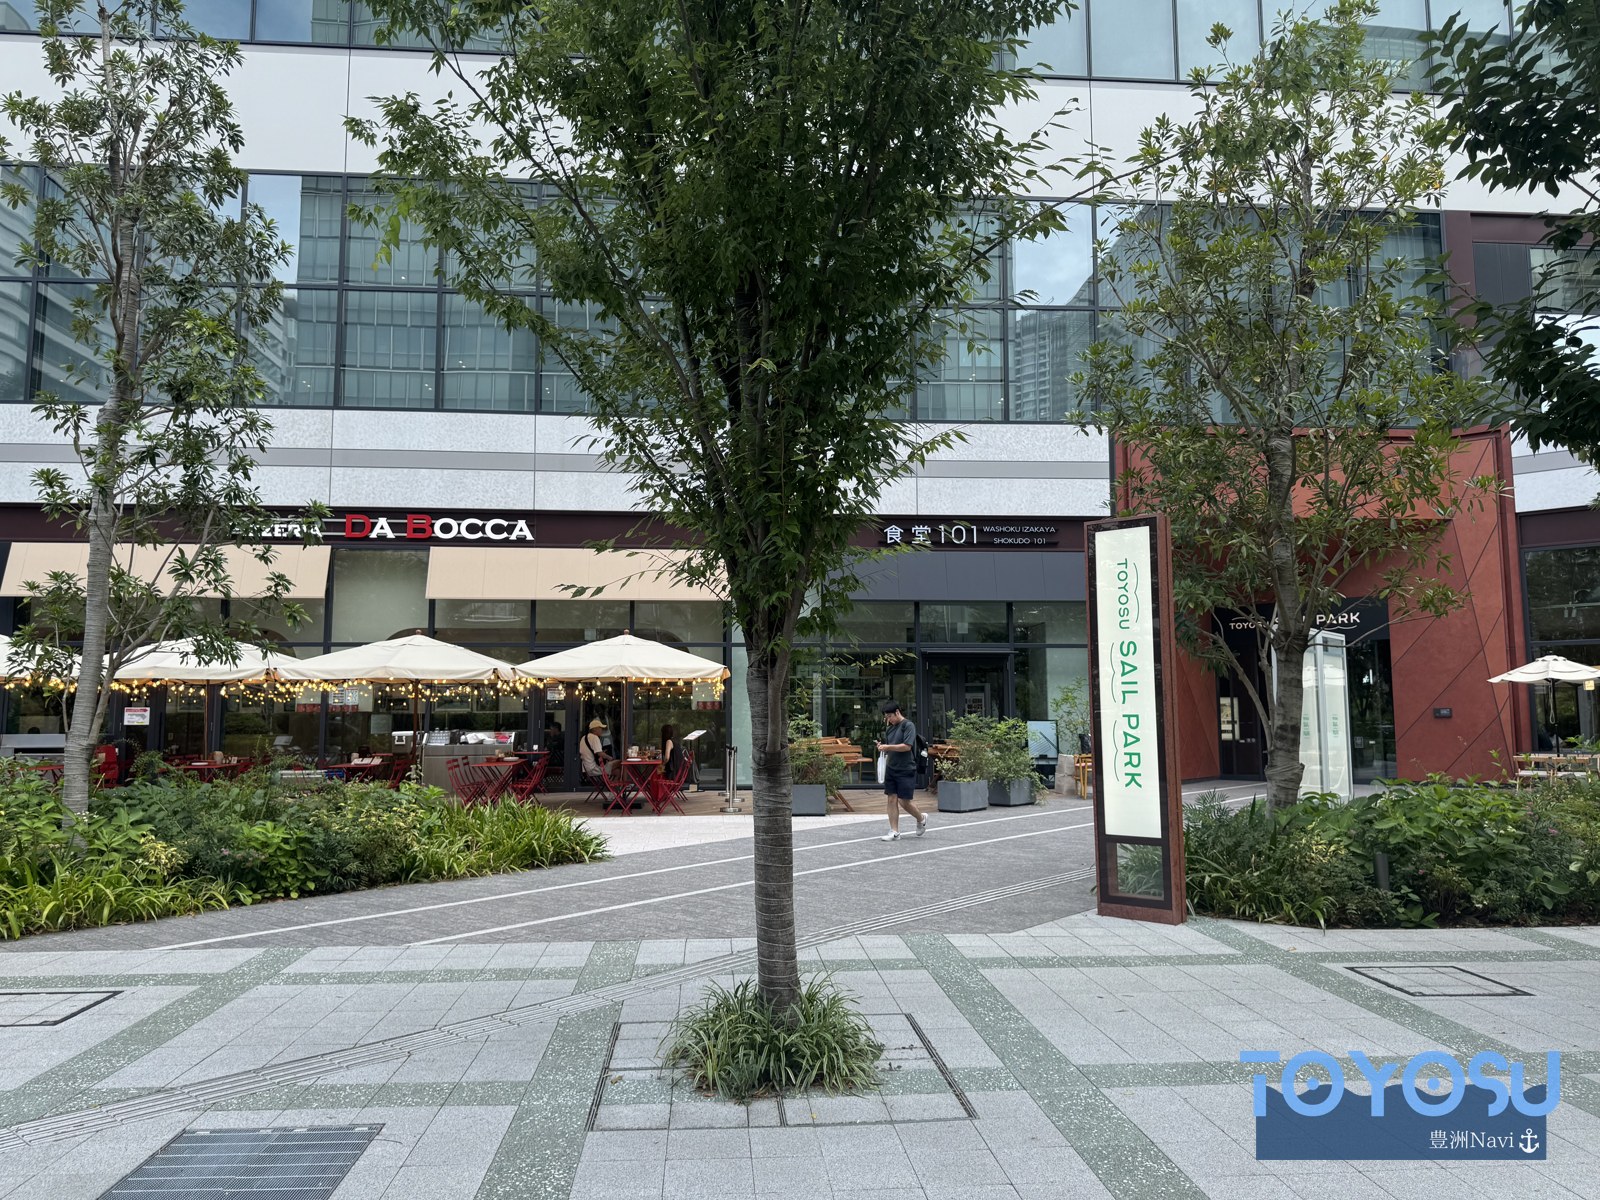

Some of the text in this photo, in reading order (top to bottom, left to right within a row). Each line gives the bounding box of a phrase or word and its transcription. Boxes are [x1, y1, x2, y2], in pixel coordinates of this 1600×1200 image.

[345, 514, 396, 539] DA
[406, 514, 535, 541] BOCCA
[982, 525, 1021, 533] WASHOKU
[993, 537, 1047, 545] SHOKUDO 101
[1229, 621, 1270, 630] TOYO
[1316, 612, 1361, 625] PARK
[1117, 558, 1142, 789] TOYOSU SAIL PARK
